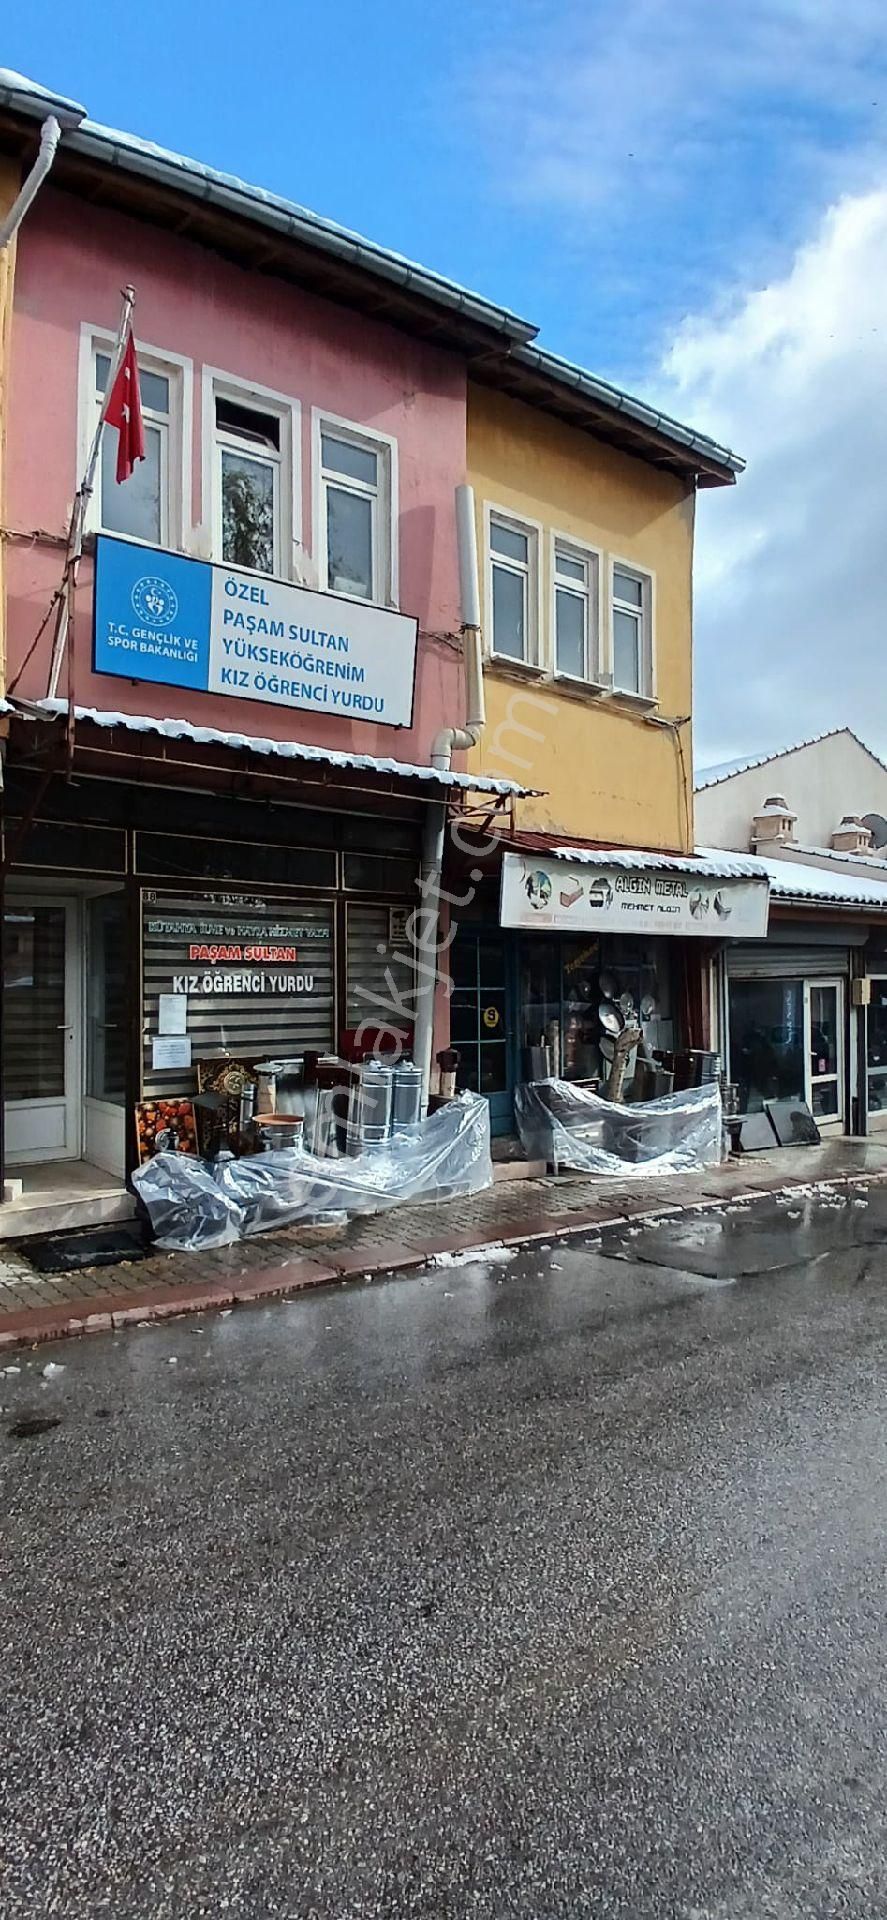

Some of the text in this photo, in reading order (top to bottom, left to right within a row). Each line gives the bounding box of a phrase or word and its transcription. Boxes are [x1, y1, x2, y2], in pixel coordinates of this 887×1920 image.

[224, 576, 269, 606] ÖZEL
[108, 622, 198, 650] T.C. GENÇLİK VE
[223, 609, 349, 652] PAŞAM SULTAN
[108, 636, 198, 663] SPOR BAKANLIĞI
[222, 637, 365, 683] YÜKSEKÖĞRENİM
[221, 667, 384, 713] KIZ ÖĞRENCİ YURDU
[615, 875, 689, 898] ALGIN METAL
[621, 902, 654, 912] MEHMET
[189, 945, 297, 964] PAŞAM SULTAN
[173, 971, 314, 993] KIZ ÖĞRENCİ YURDU
